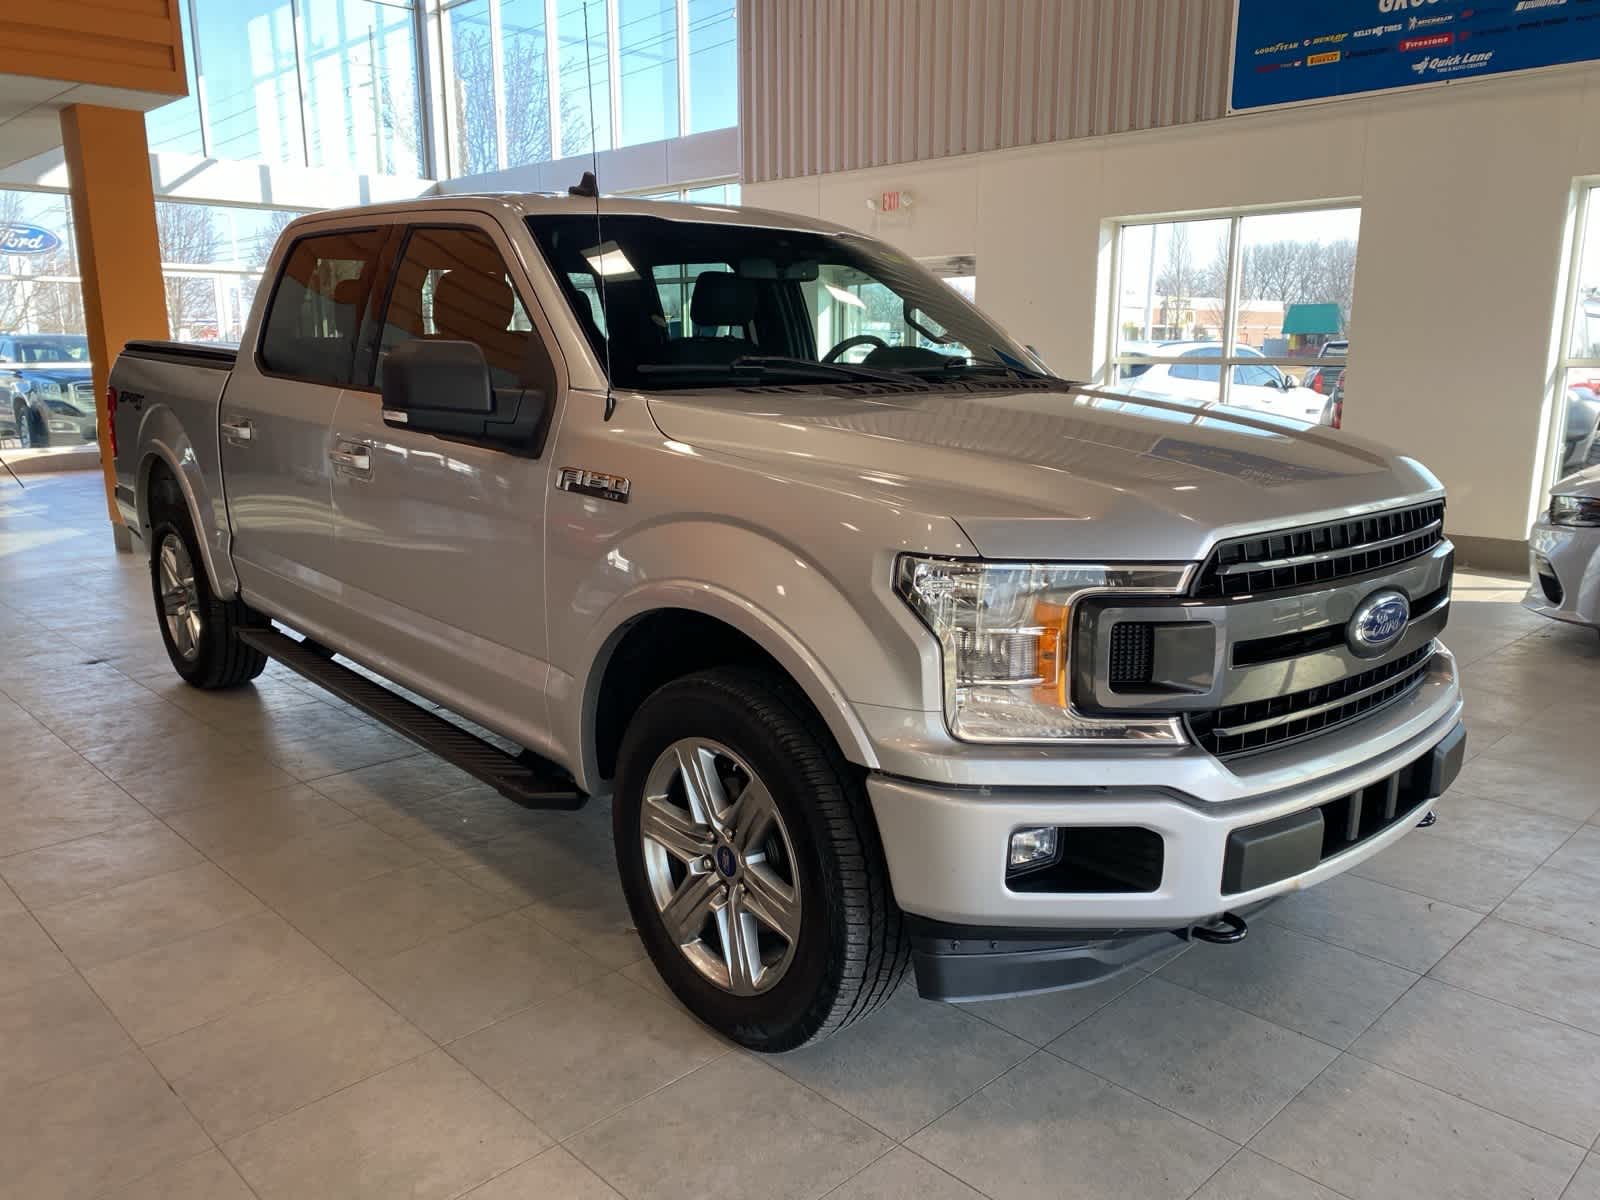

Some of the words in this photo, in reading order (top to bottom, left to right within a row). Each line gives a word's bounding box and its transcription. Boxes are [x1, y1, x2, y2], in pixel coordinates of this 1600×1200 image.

[1353, 29, 1372, 38] KELLY
[1384, 23, 1403, 32] TIRES
[1313, 33, 1349, 45] DUNLOP
[1254, 42, 1299, 55] GOODYEAR
[1429, 54, 1461, 69] Quick
[1462, 51, 1493, 64] Lane
[882, 191, 900, 210] EXIT
